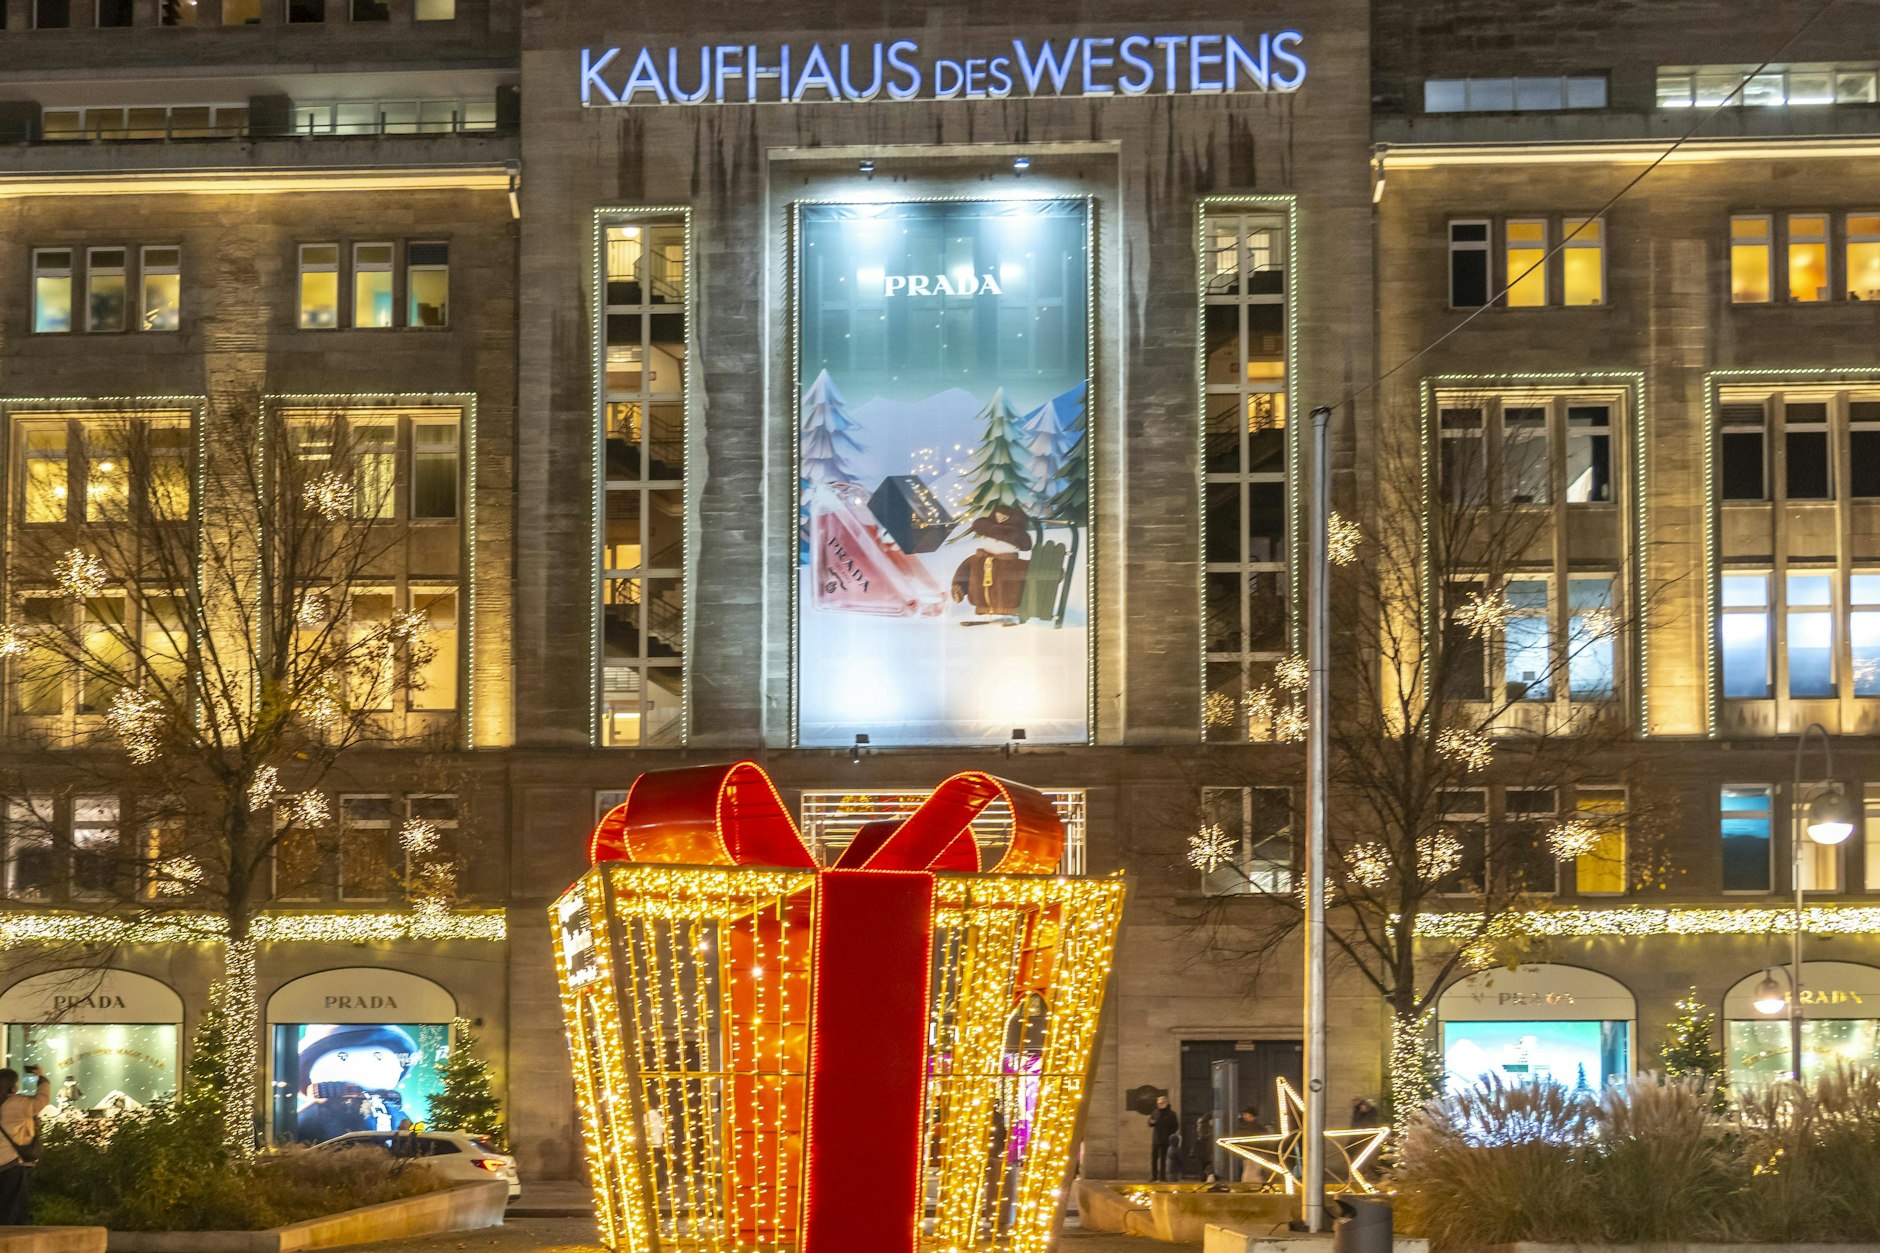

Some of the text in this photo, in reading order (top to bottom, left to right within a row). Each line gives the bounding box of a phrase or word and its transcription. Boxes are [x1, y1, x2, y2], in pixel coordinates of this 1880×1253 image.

[580, 30, 1307, 106] KAUFHAUS DES WESTENS
[884, 273, 1003, 297] PRADA
[827, 536, 869, 593] PRADA
[54, 995, 126, 1009] PRADA
[324, 995, 398, 1009] PRADA
